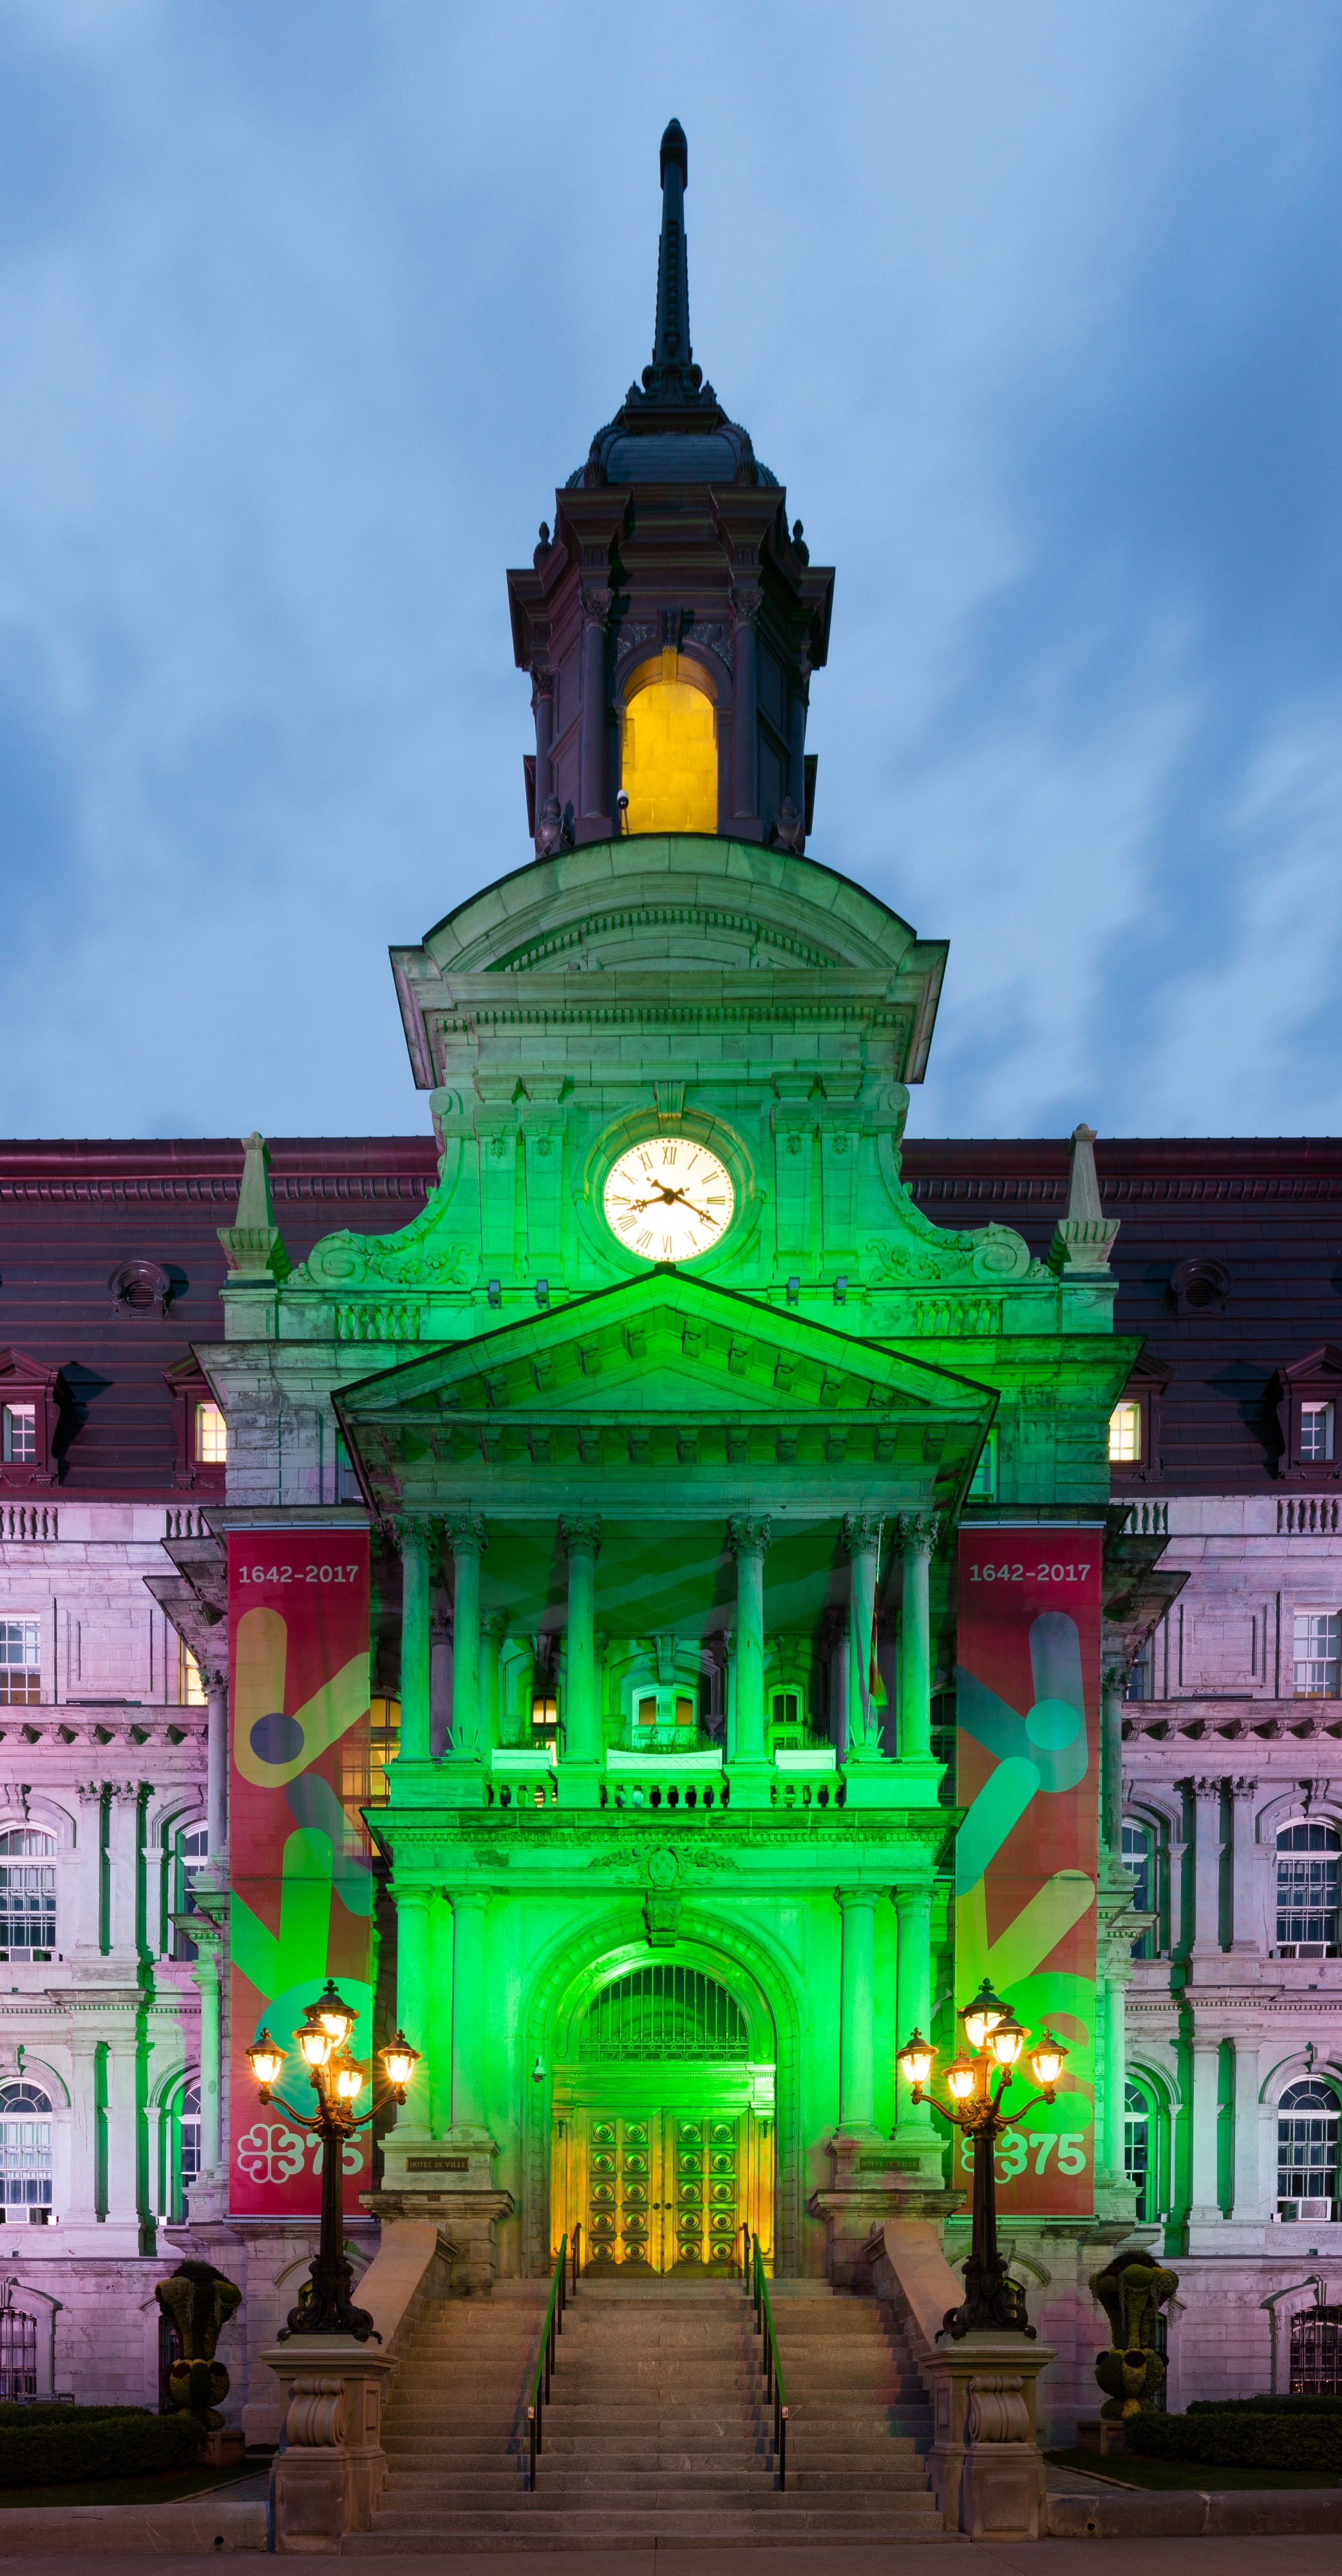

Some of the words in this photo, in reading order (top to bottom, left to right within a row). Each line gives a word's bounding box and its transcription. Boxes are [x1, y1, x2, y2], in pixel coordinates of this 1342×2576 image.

[637, 1151, 654, 1172] XI
[662, 1147, 677, 1165] XII
[687, 1153, 699, 1170] I
[619, 1170, 638, 1185] X
[701, 1171, 719, 1185] II
[706, 1195, 726, 1206] III
[616, 1209, 638, 1233] VIII
[636, 1227, 654, 1249] VII
[662, 1236, 672, 1253] VI
[685, 1230, 697, 1246] V
[239, 1565, 359, 1584] 1642-2017
[970, 1564, 1091, 1582] 1642-2017
[1002, 2133, 1086, 2175] 375
